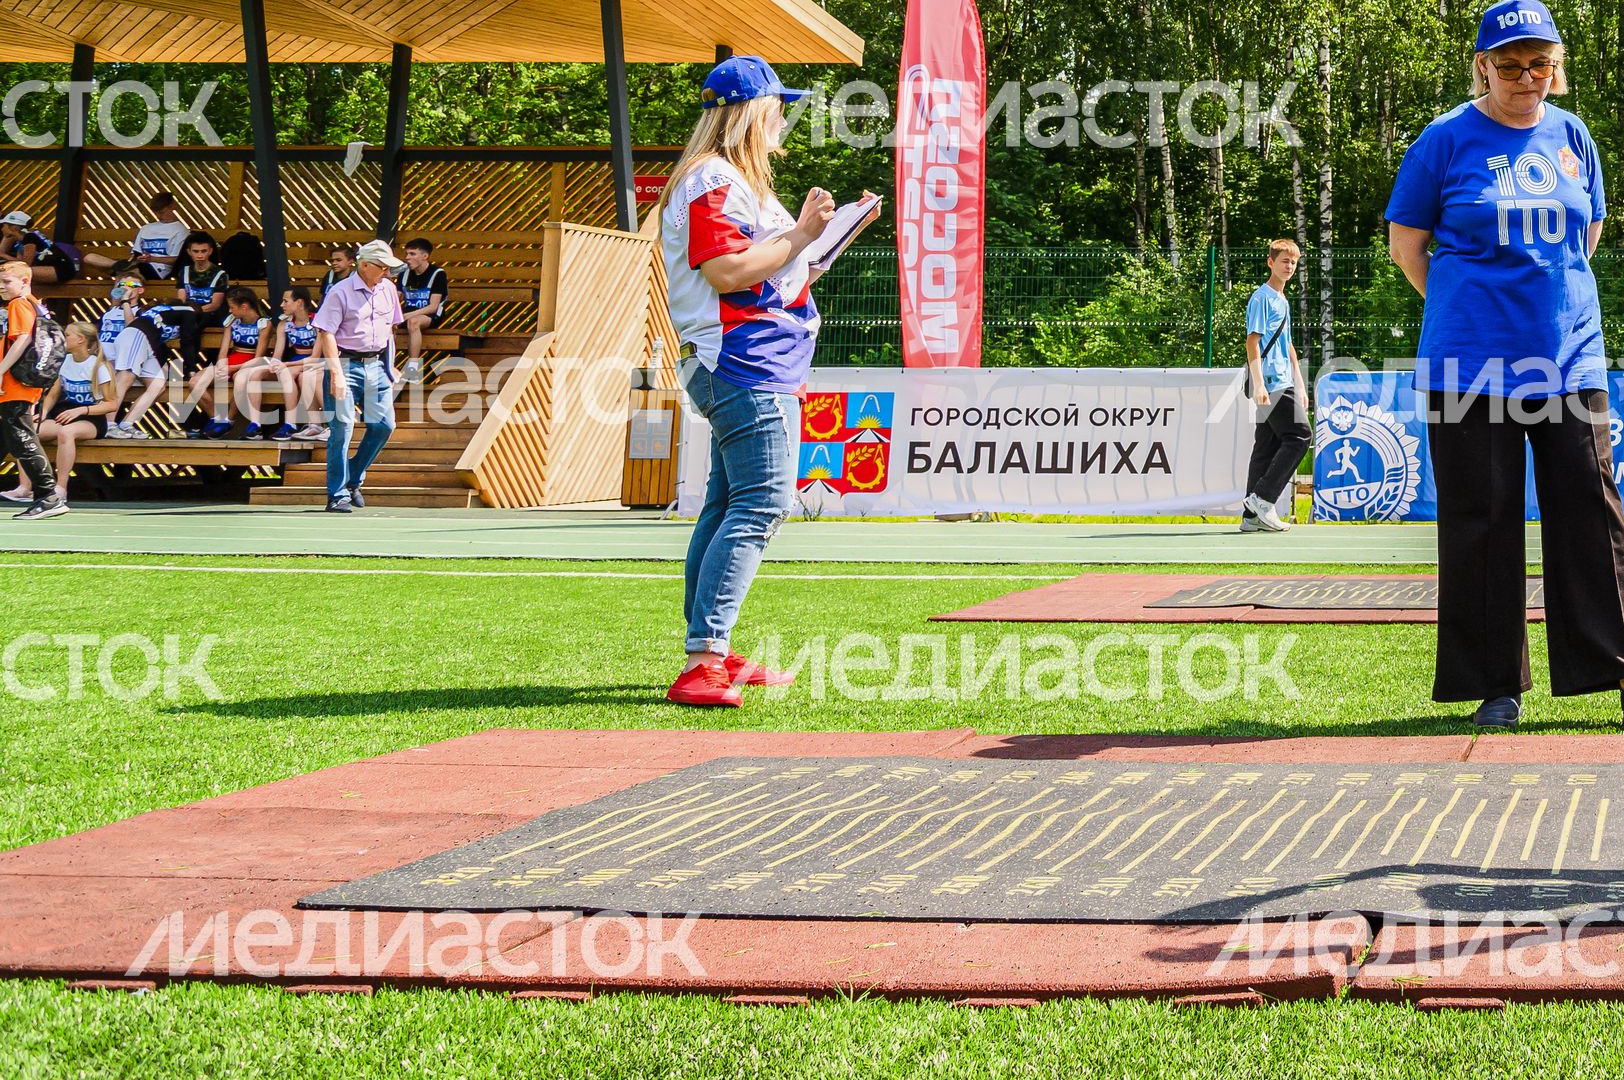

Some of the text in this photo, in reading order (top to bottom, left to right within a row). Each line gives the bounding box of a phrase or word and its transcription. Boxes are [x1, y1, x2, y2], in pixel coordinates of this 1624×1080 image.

[1487, 153, 1557, 196] 10
[1497, 199, 1567, 246] ГТО
[910, 404, 1175, 429] ГОРОДСКОЙ ОКРУГ
[907, 441, 1172, 474] БАЛАШИХА
[1333, 487, 1370, 505] ГТО
